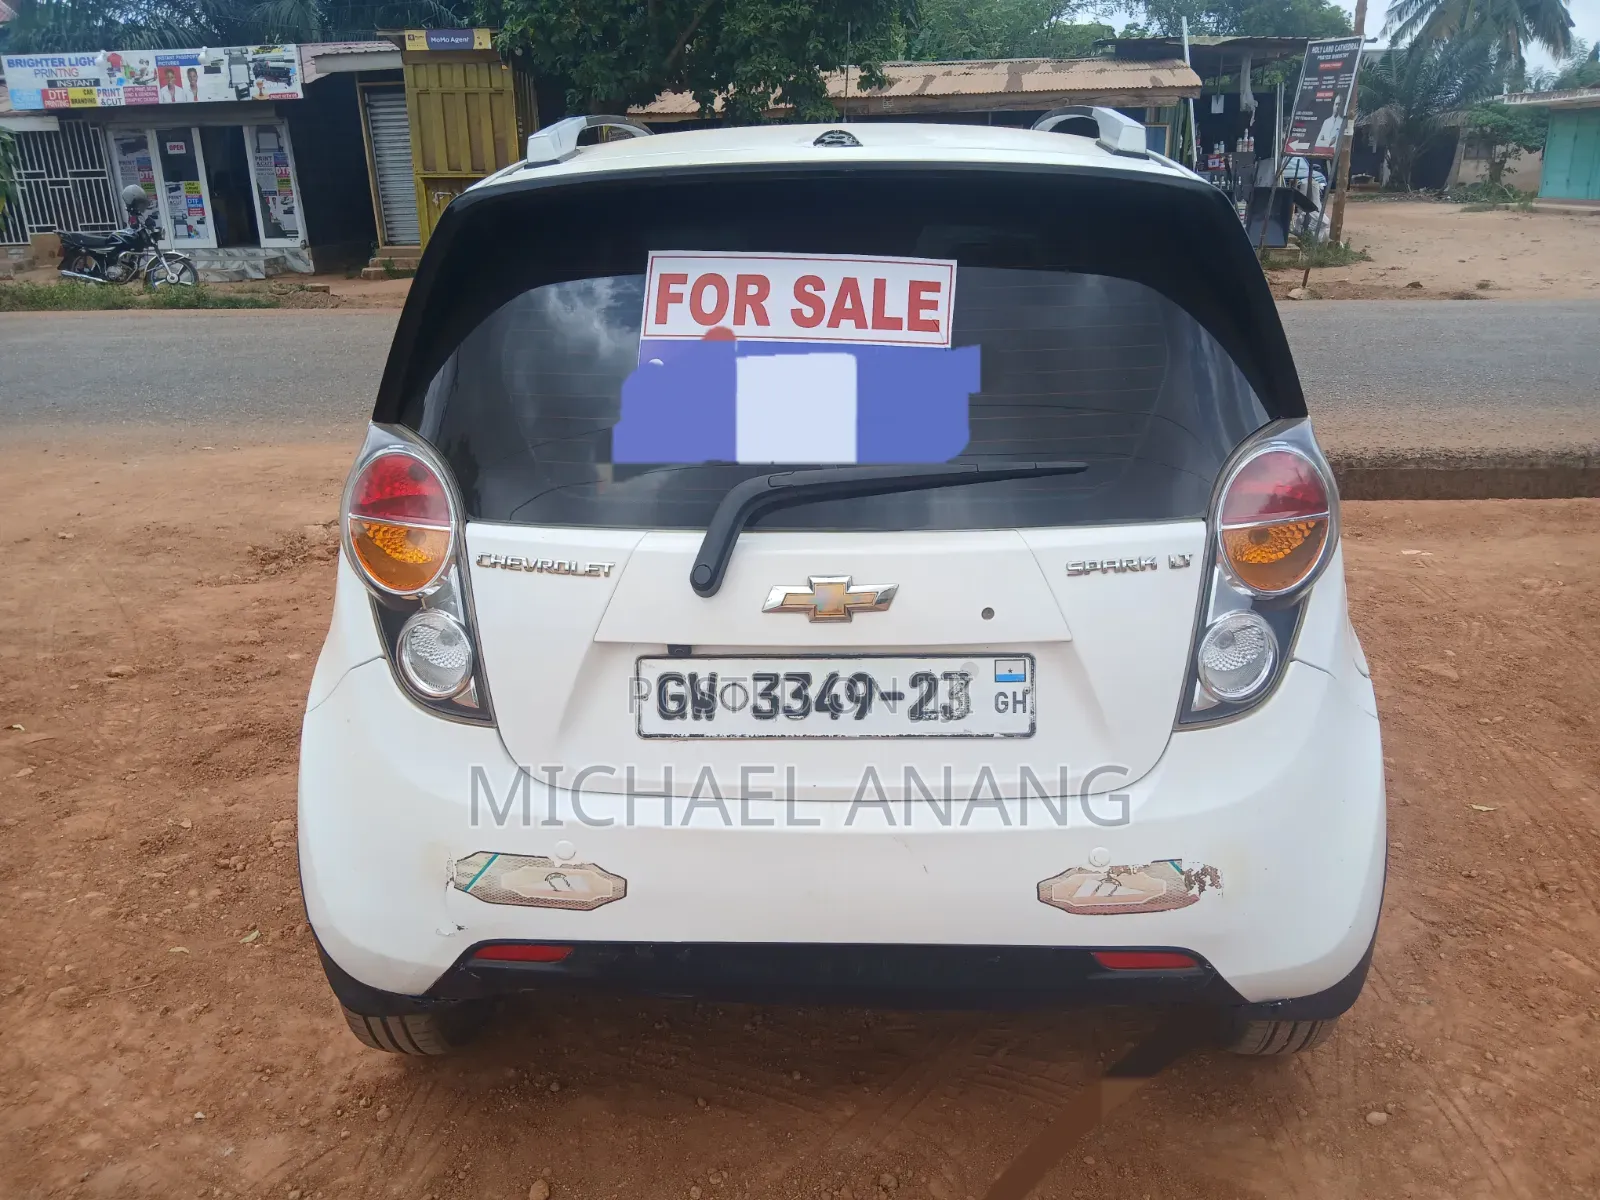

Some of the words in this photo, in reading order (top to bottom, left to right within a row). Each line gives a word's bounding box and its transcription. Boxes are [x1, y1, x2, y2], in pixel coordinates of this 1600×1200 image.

[451, 36, 469, 44] Agent
[7, 57, 67, 68] BRIGHTER
[69, 56, 98, 67] LIGH
[49, 89, 68, 100] DTF
[97, 88, 120, 98] PRINT
[45, 100, 69, 108] PRINTING
[71, 97, 97, 105] BRANDING
[654, 272, 771, 327] FOR
[790, 274, 942, 333] SALE
[476, 552, 615, 577] CHEVROLET
[1066, 556, 1158, 577] SPARK
[1168, 553, 1192, 569] LT
[656, 671, 719, 721] GW
[994, 691, 1027, 714] GH
